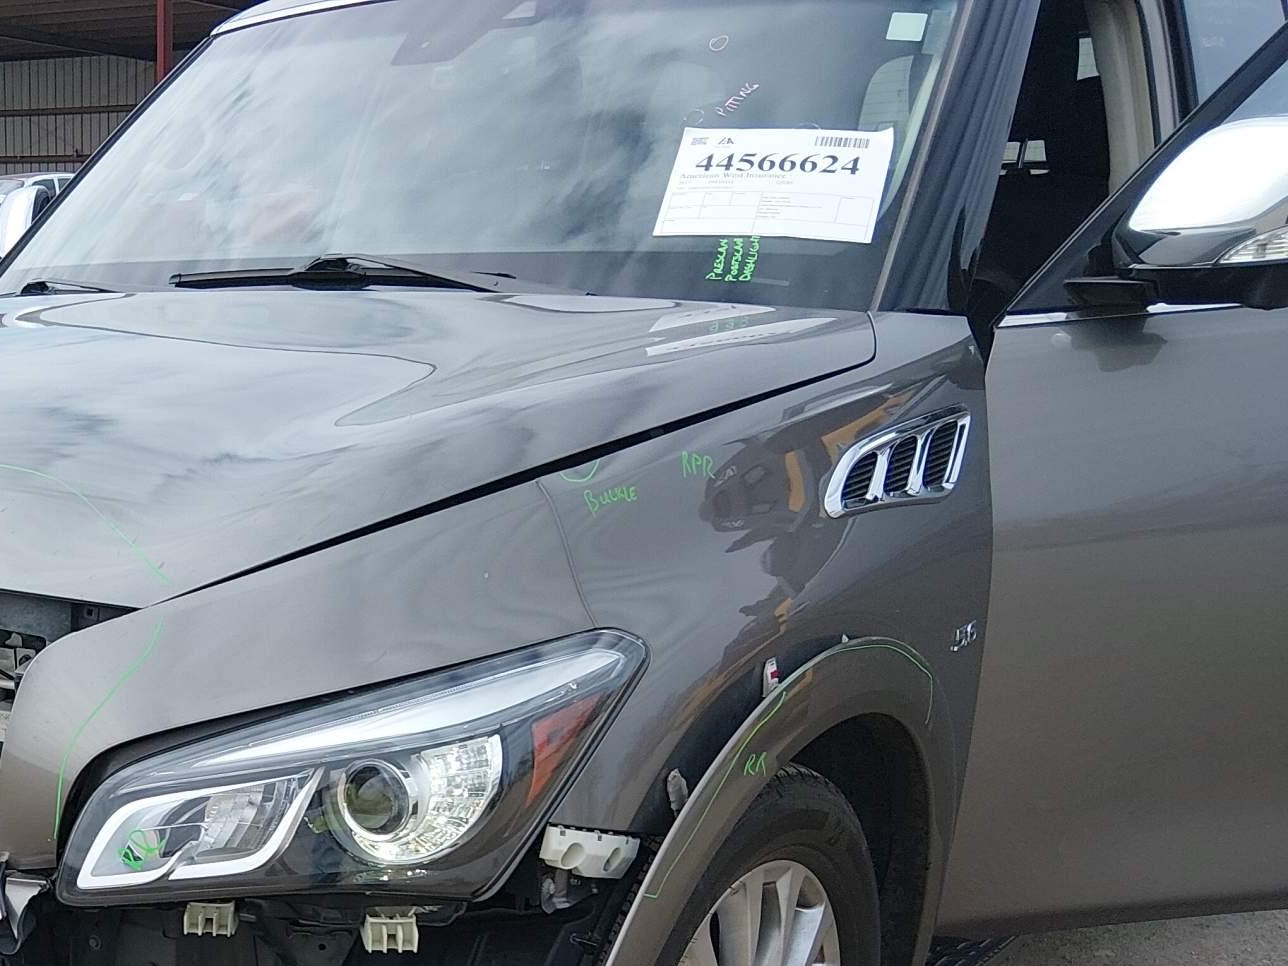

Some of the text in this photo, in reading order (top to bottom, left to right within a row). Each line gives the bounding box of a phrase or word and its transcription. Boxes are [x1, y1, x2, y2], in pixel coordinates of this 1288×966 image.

[695, 152, 861, 175] 44566624
[705, 239, 728, 280] PRESCAN
[681, 451, 715, 479] RPR
